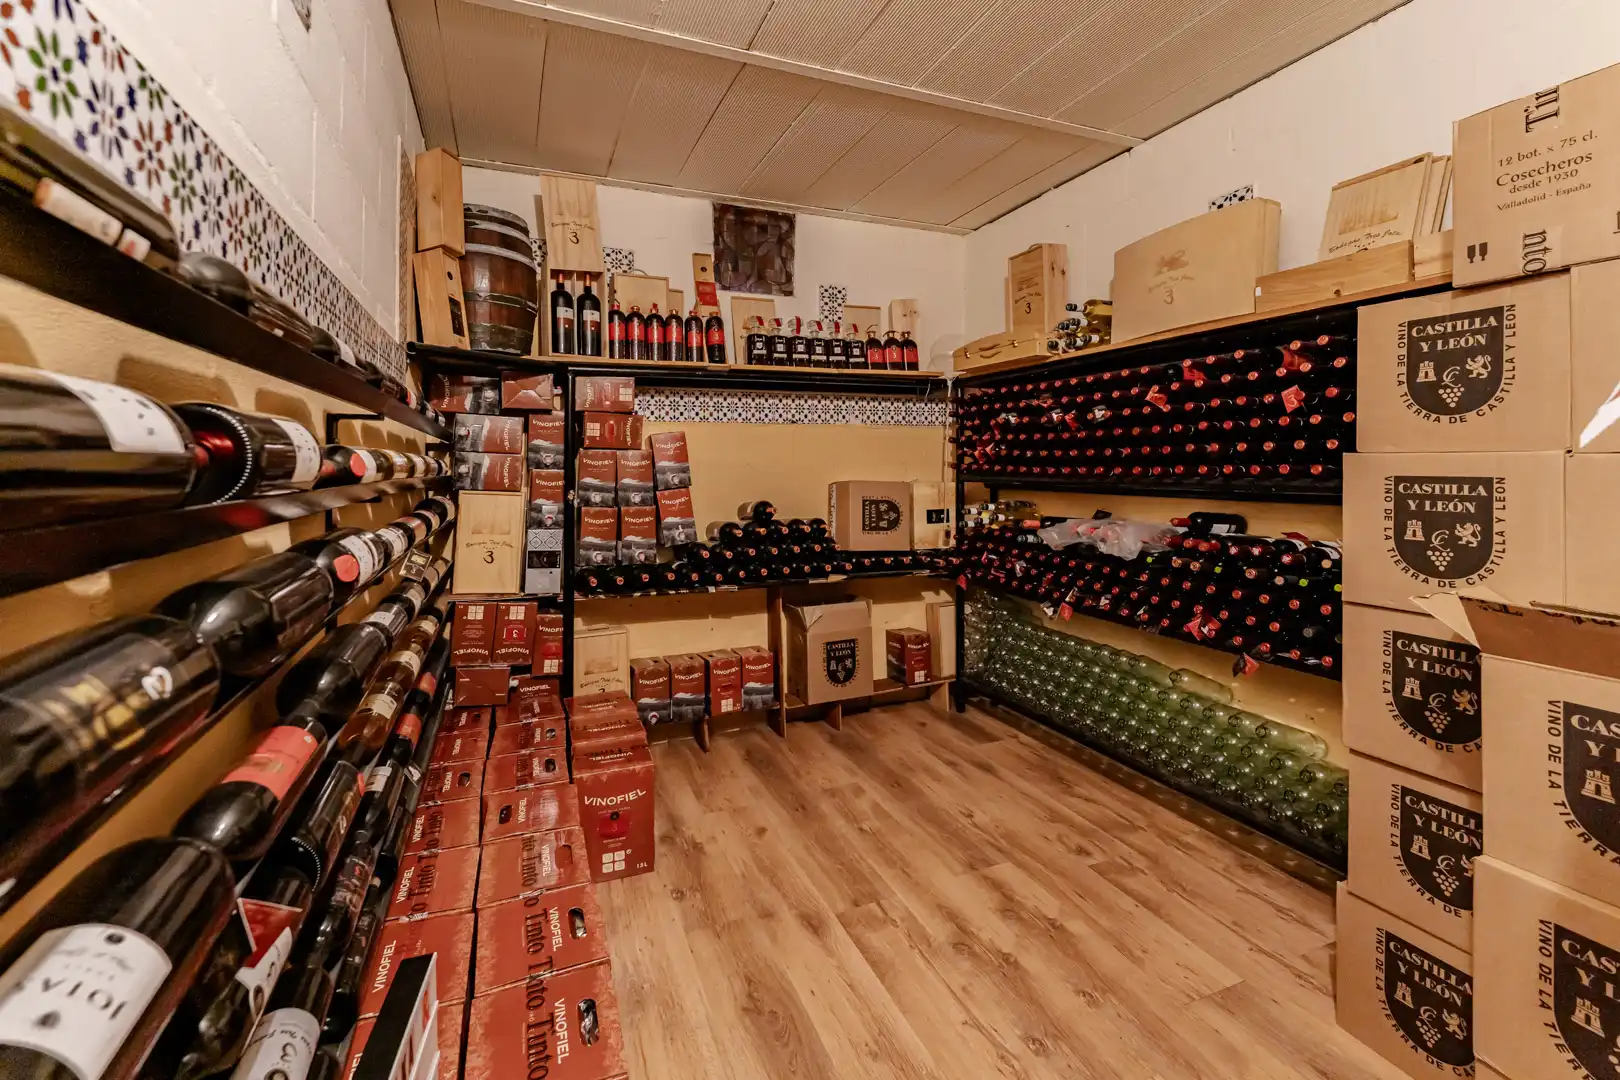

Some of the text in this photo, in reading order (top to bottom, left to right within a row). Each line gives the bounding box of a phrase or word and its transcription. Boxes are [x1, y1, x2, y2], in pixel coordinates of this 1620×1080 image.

[1497, 156, 1513, 168] 12
[1517, 149, 1542, 163] bot.
[1559, 136, 1578, 149] 75
[1582, 130, 1599, 142] cl.
[1496, 152, 1593, 187] Cosecheros
[1509, 168, 1579, 194] desde 1930
[1497, 193, 1546, 211] Valladolid
[1556, 181, 1592, 197] España
[569, 231, 580, 245] 3
[1024, 302, 1032, 315] 3
[1411, 315, 1499, 337] CASTILLA
[1419, 332, 1487, 353] Y LEÓN
[1397, 304, 1516, 424] VINO DE LA TIERRA DE CASTILLA Y LEON
[1398, 483, 1488, 496] CASTILLA
[1406, 499, 1476, 513] Y LEÓN
[1384, 476, 1506, 588] VINO DE LA TIERRA DE CASTILLA Y LEON
[483, 550, 495, 564] 3
[1405, 657, 1473, 681] Y LEÓN
[1383, 630, 1454, 753] VINO DE LA TIERRA DE
[1548, 700, 1561, 737] VINO
[1548, 743, 1561, 764] DE
[1583, 739, 1606, 757] Y
[1548, 769, 1562, 789] LA
[584, 788, 647, 806] VINOFIEL
[1413, 813, 1481, 850] Y LEÓN
[541, 843, 551, 877] VINOFIEL
[1390, 783, 1462, 918] VINO DE LA TIERRA DE
[396, 866, 415, 904] VINOFIEL
[525, 908, 549, 954] Tinto
[549, 906, 563, 952] VINOFIEL
[1539, 919, 1552, 958] VINO
[372, 940, 396, 993] VINOFIEL
[1389, 941, 1473, 995] CASTILLA
[1397, 960, 1408, 975] Y
[1539, 963, 1552, 986] DE
[1575, 966, 1595, 988] Y
[1375, 927, 1445, 1071] VINO DE LA TIERRA DE
[1539, 988, 1553, 1011] LA
[527, 1012, 556, 1080] Tinto
[554, 998, 570, 1064] VINOFIEL
